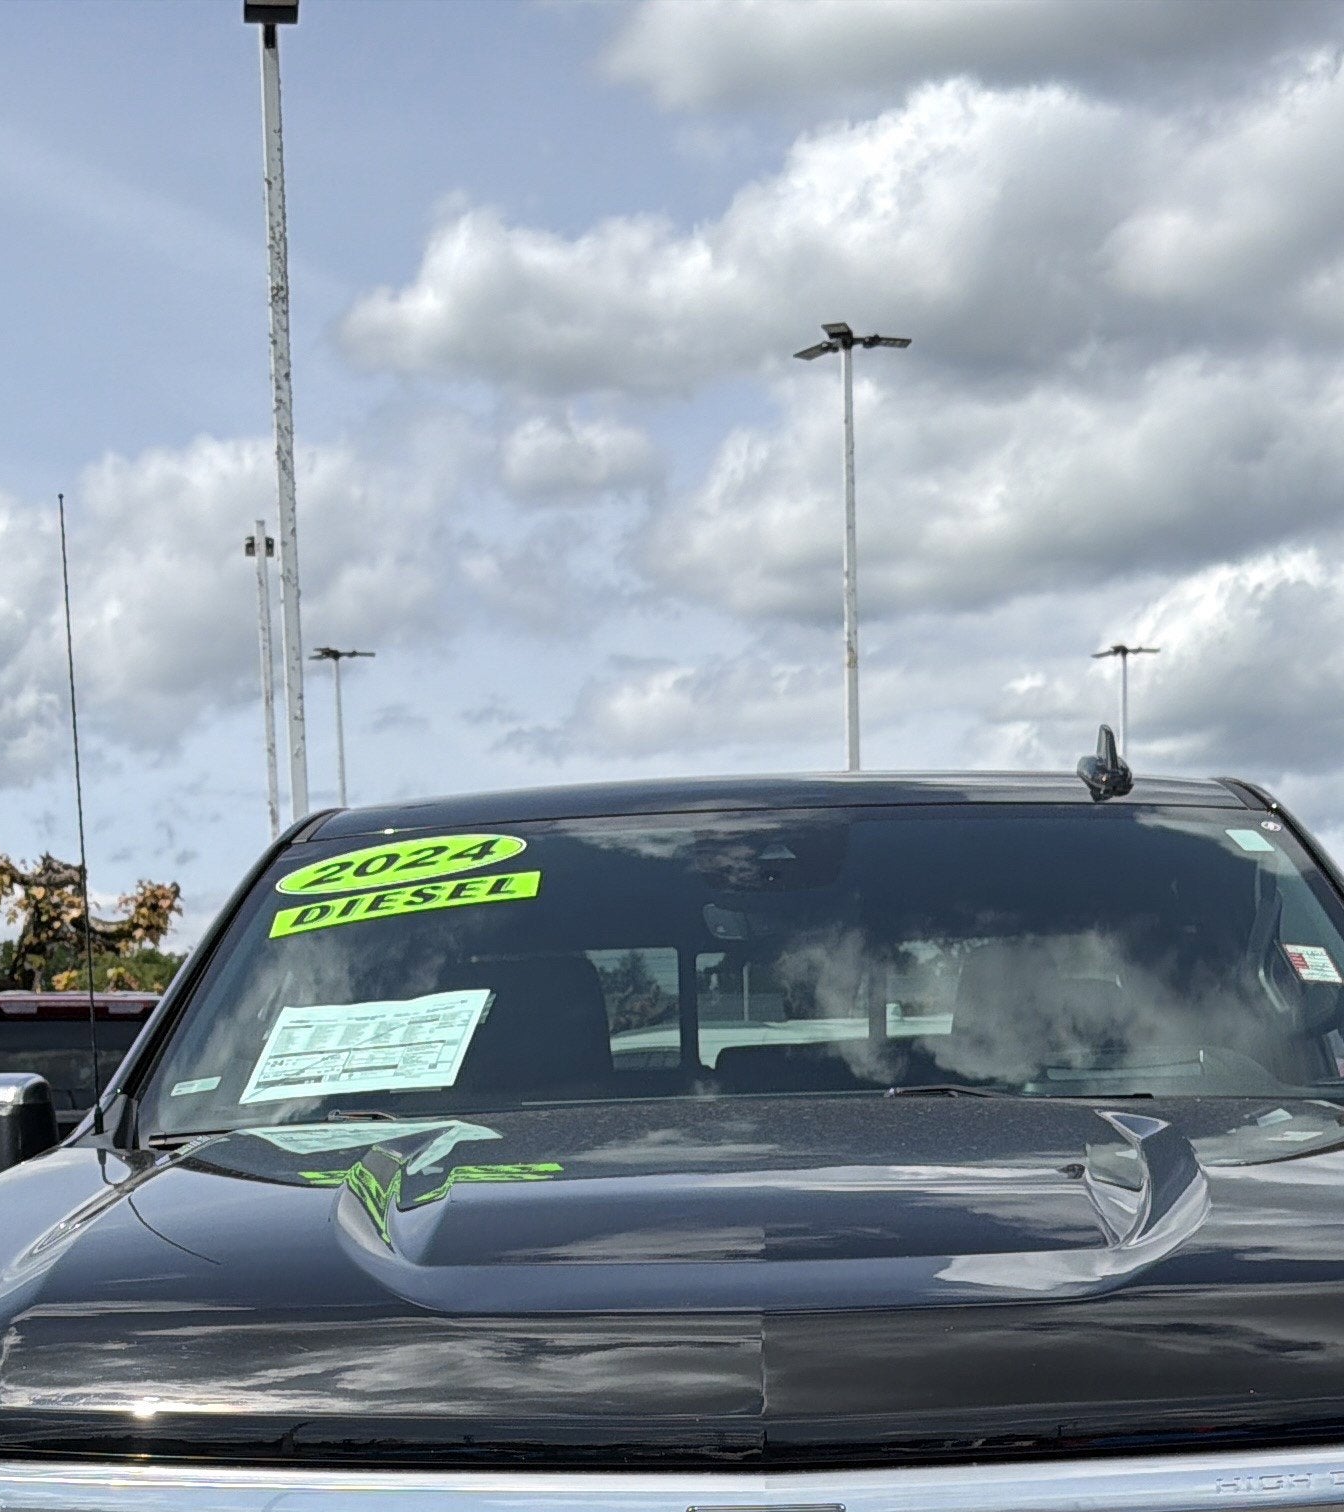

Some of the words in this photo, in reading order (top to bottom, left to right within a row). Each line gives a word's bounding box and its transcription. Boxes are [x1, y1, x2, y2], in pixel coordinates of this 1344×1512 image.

[299, 837, 503, 890] 2024
[289, 876, 518, 929] DIESEL
[1215, 1472, 1313, 1495] HIGH
